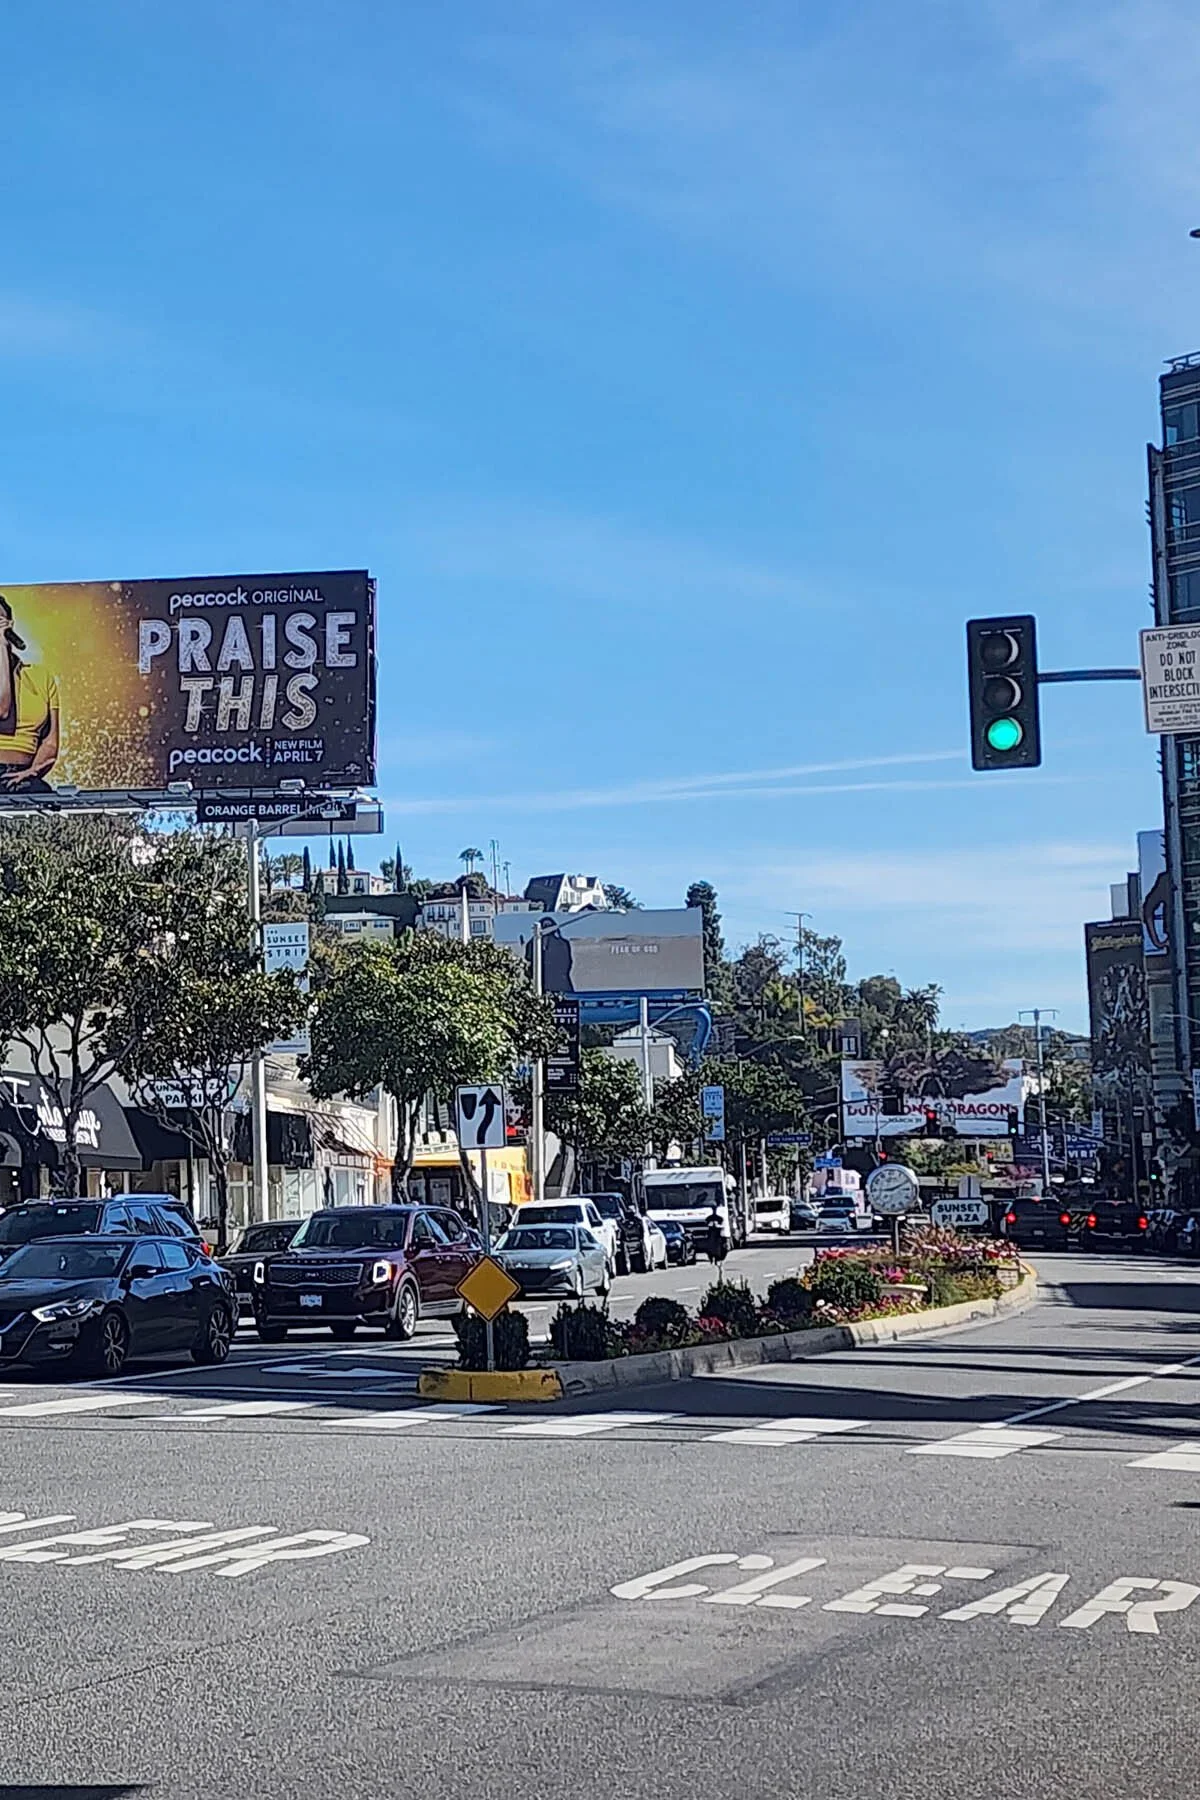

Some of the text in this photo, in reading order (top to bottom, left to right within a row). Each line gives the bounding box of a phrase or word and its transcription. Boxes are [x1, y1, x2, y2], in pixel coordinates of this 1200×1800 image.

[170, 586, 324, 615] peacock ORIGINAL
[138, 612, 357, 674] PRAISE
[1166, 641, 1188, 650] ZONE
[1160, 651, 1196, 666] DO NOT
[1164, 667, 1195, 682] BLOCK
[179, 674, 319, 732] THIS
[169, 739, 323, 774] peacock NEW FILM
[274, 750, 324, 763] APRIL 7
[205, 804, 256, 816] ORANGE
[258, 804, 301, 816] BARREL
[266, 935, 307, 944] SUNSET
[267, 948, 307, 958] STRIP
[937, 1203, 981, 1213] SUNSET
[942, 1213, 980, 1223] PLAZA
[608, 1552, 1200, 1635] CLEAR
